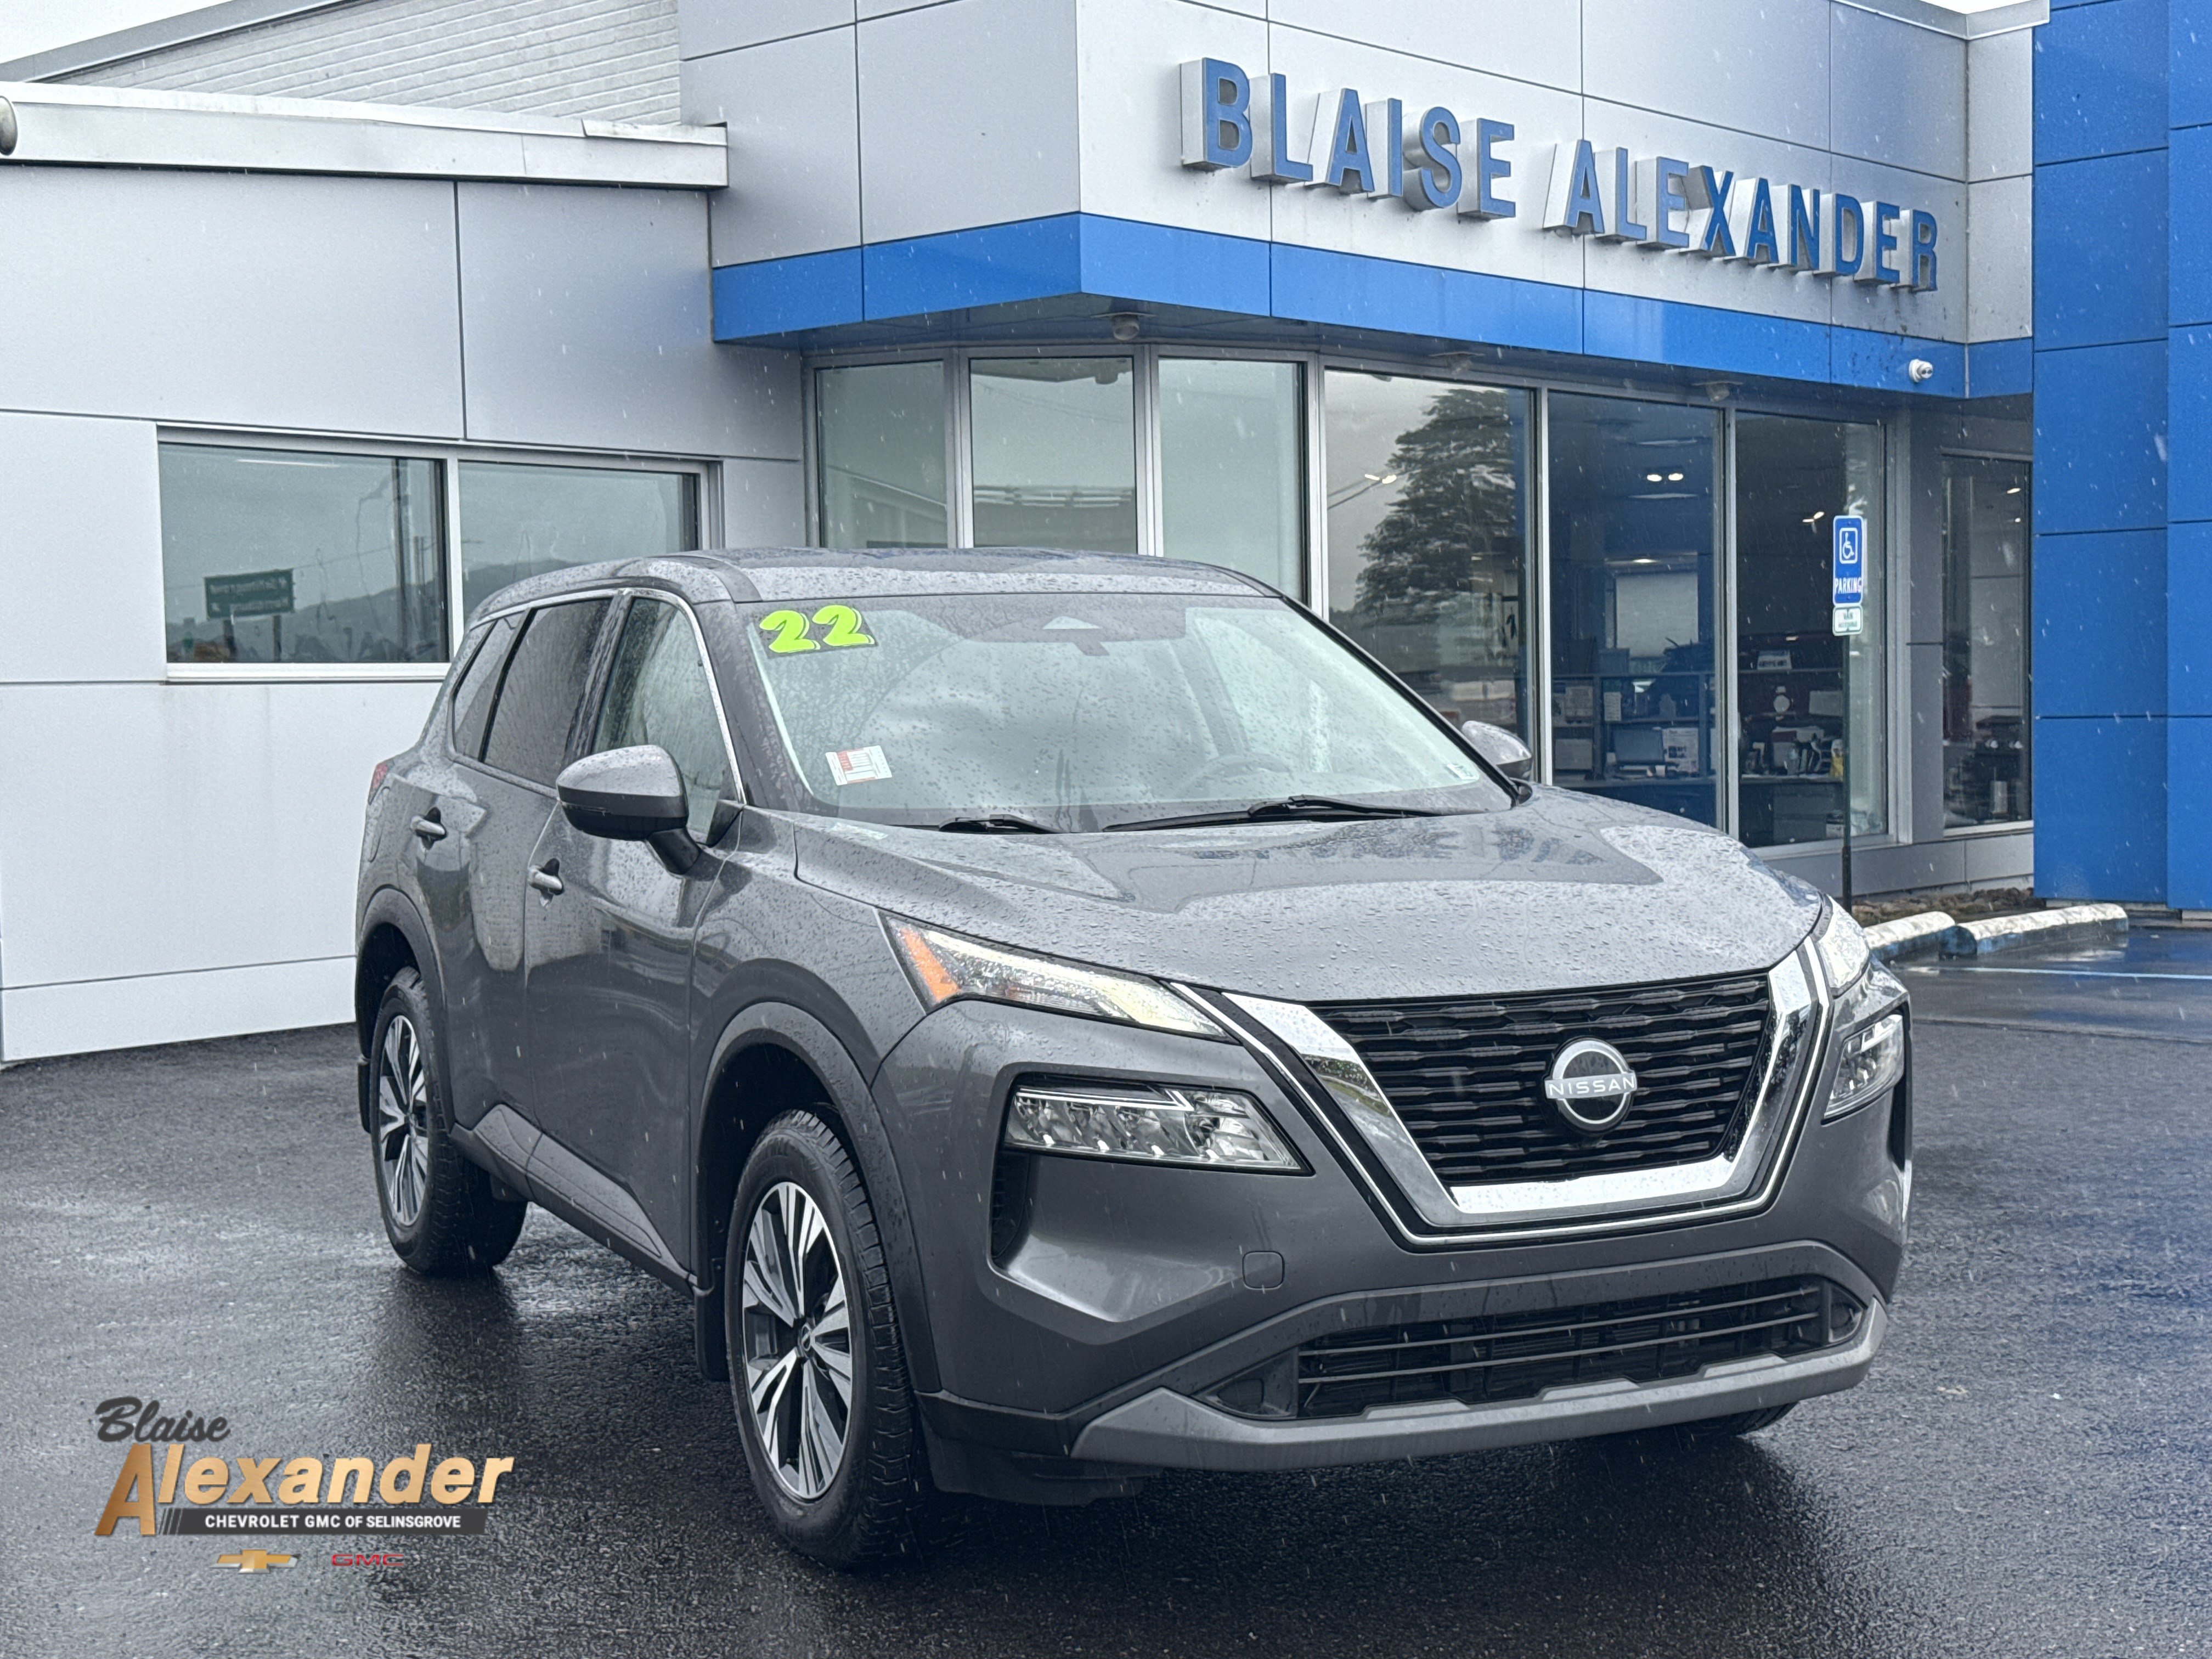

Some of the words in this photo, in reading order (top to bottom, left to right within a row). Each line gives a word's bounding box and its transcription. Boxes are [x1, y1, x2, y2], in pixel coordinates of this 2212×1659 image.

[1196, 57, 1516, 218] BLAISE
[1555, 139, 1938, 291] ALEXANDER
[1835, 577, 1861, 594] PARKING
[759, 605, 875, 653] 22
[1549, 1076, 1635, 1096] NISSAN
